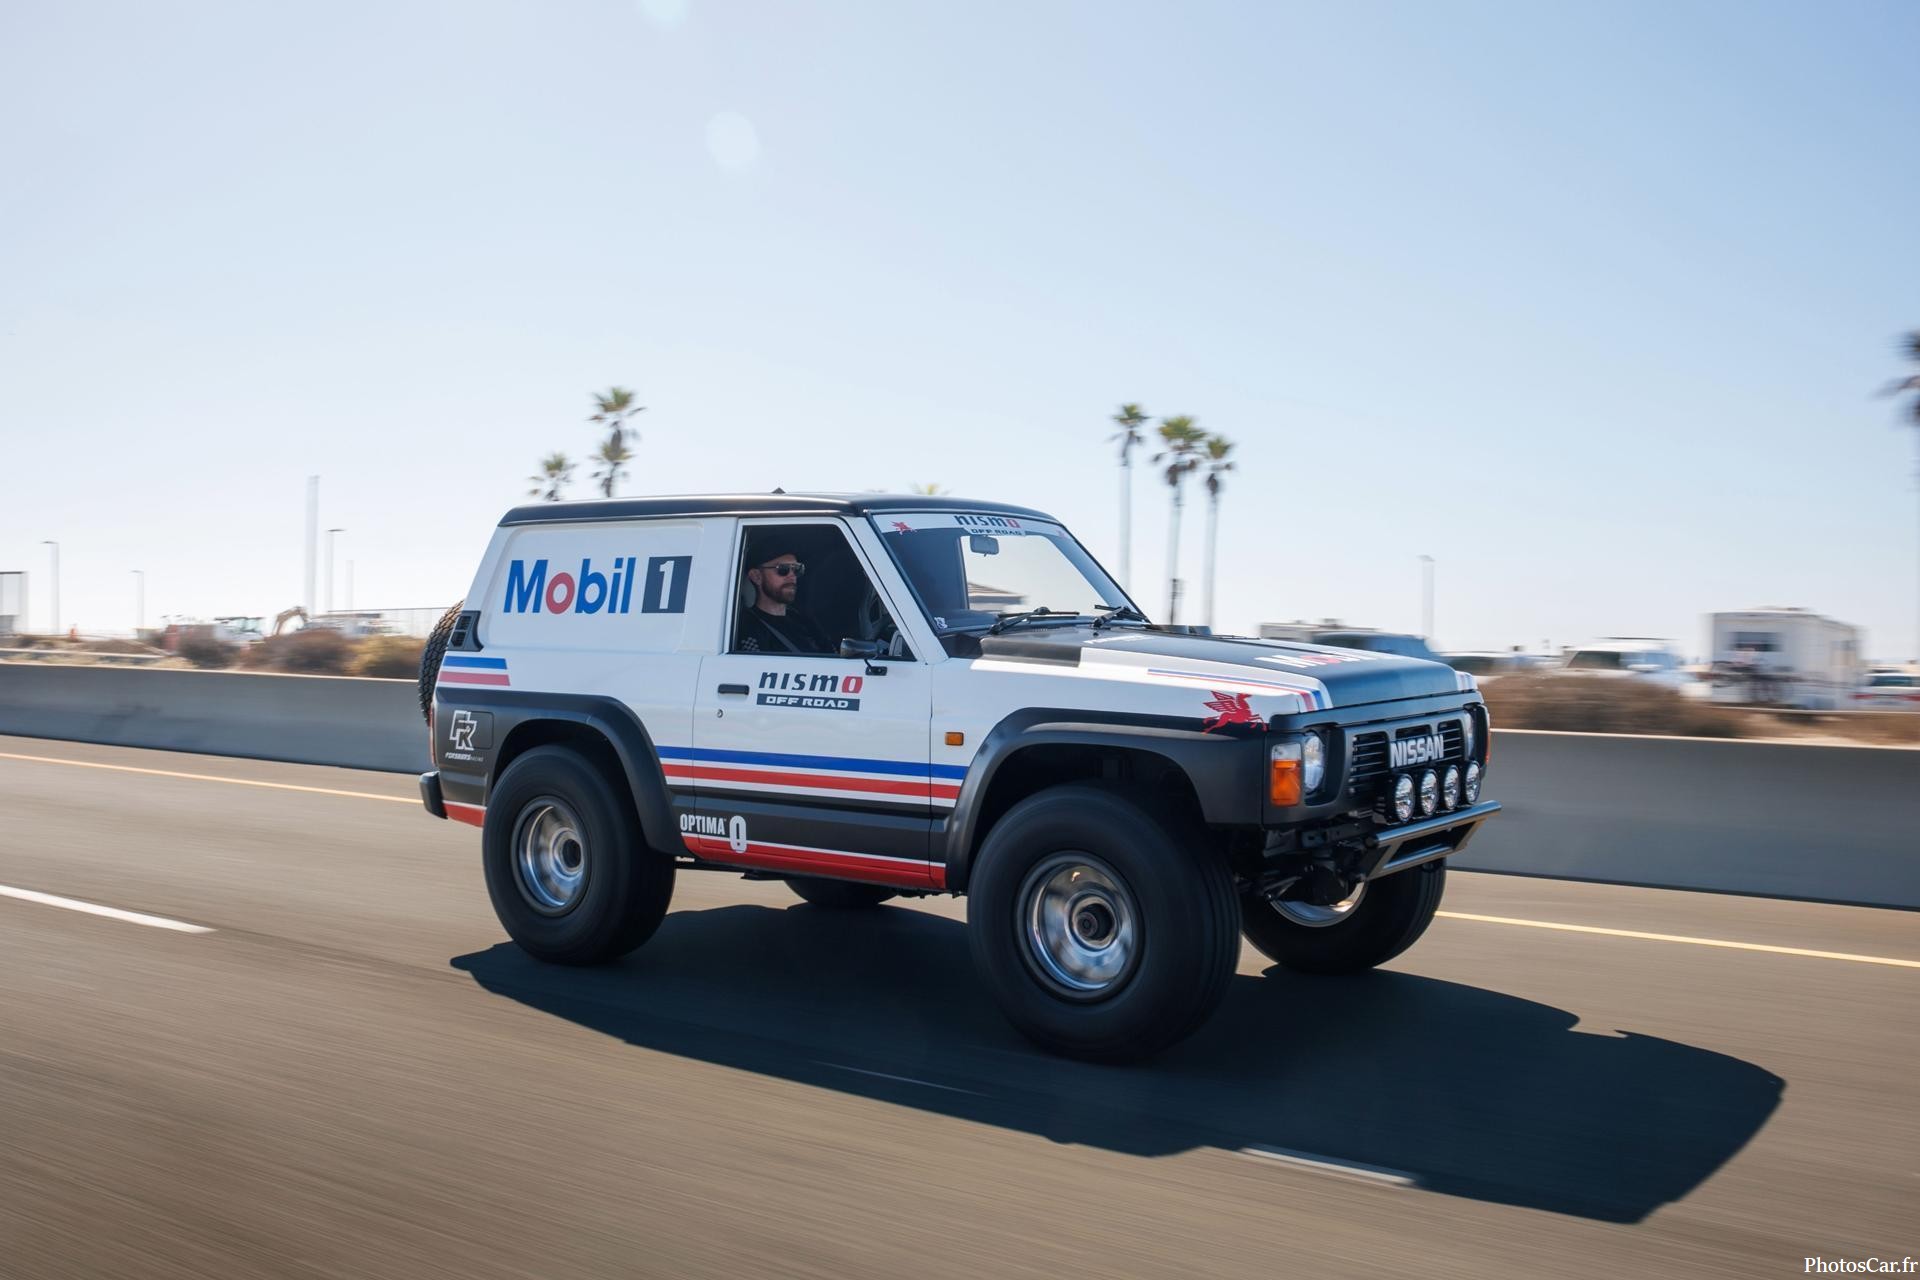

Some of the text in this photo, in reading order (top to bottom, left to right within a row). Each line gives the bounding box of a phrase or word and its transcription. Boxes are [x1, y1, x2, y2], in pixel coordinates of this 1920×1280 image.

[953, 515, 1021, 529] nismo
[503, 557, 637, 615] Mobil
[758, 671, 864, 694] nismo
[765, 695, 849, 709] OFF ROAD
[1390, 734, 1444, 768] NISSAN
[680, 813, 726, 835] OPTIMA
